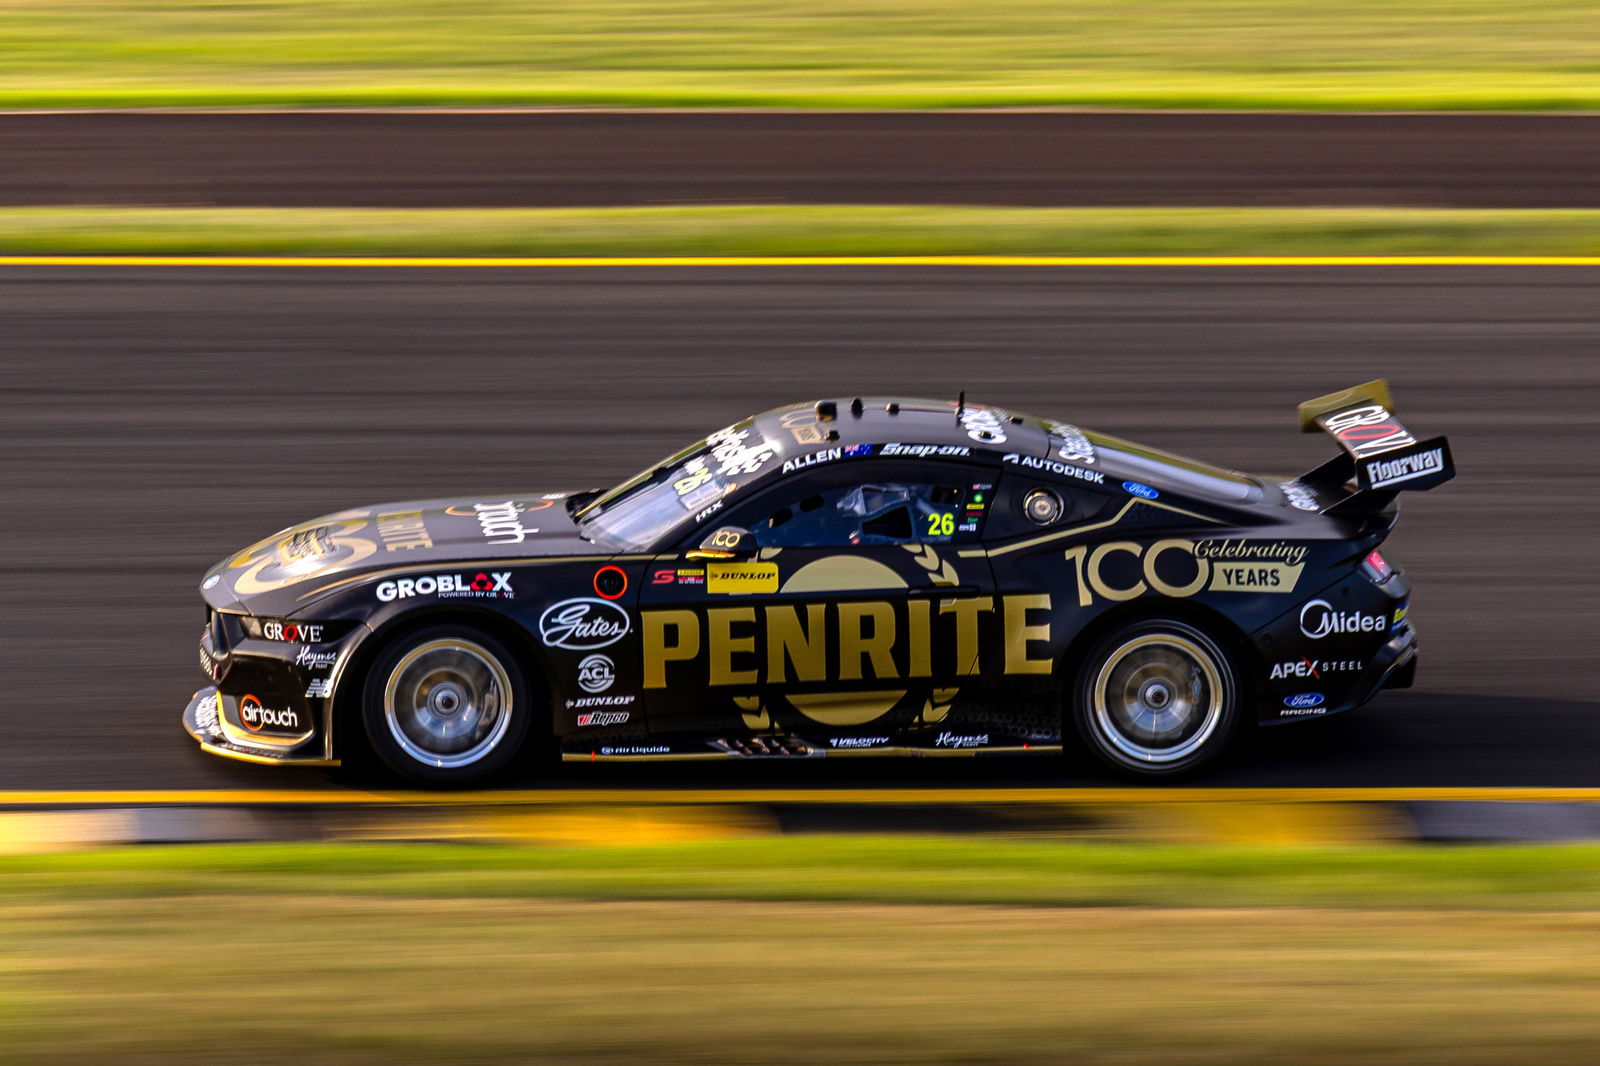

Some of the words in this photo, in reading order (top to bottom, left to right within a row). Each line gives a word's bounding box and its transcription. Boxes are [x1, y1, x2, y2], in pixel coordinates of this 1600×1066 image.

[782, 446, 841, 474] ALLEN
[1021, 455, 1104, 485] AUTODESK
[1366, 447, 1443, 486] Floorway
[928, 512, 955, 536] 26
[720, 572, 776, 580] DUNLOP
[1065, 539, 1209, 607] 100
[1193, 538, 1310, 565] Celebrating
[1222, 567, 1281, 587] YEARS
[264, 622, 322, 643] GROVE
[544, 603, 626, 644] Gates
[1308, 607, 1386, 635] Midea
[640, 592, 1054, 689] PENRITE
[295, 645, 336, 670] Haymes
[1269, 657, 1320, 680] APEX
[1322, 660, 1364, 672] STEEL
[578, 668, 615, 680] ACL
[575, 696, 635, 708] DUNLOP
[242, 703, 298, 727] airtouch
[631, 746, 670, 754] Liquide
[838, 737, 890, 746] VELOCITY
[935, 731, 989, 748] Haymes
